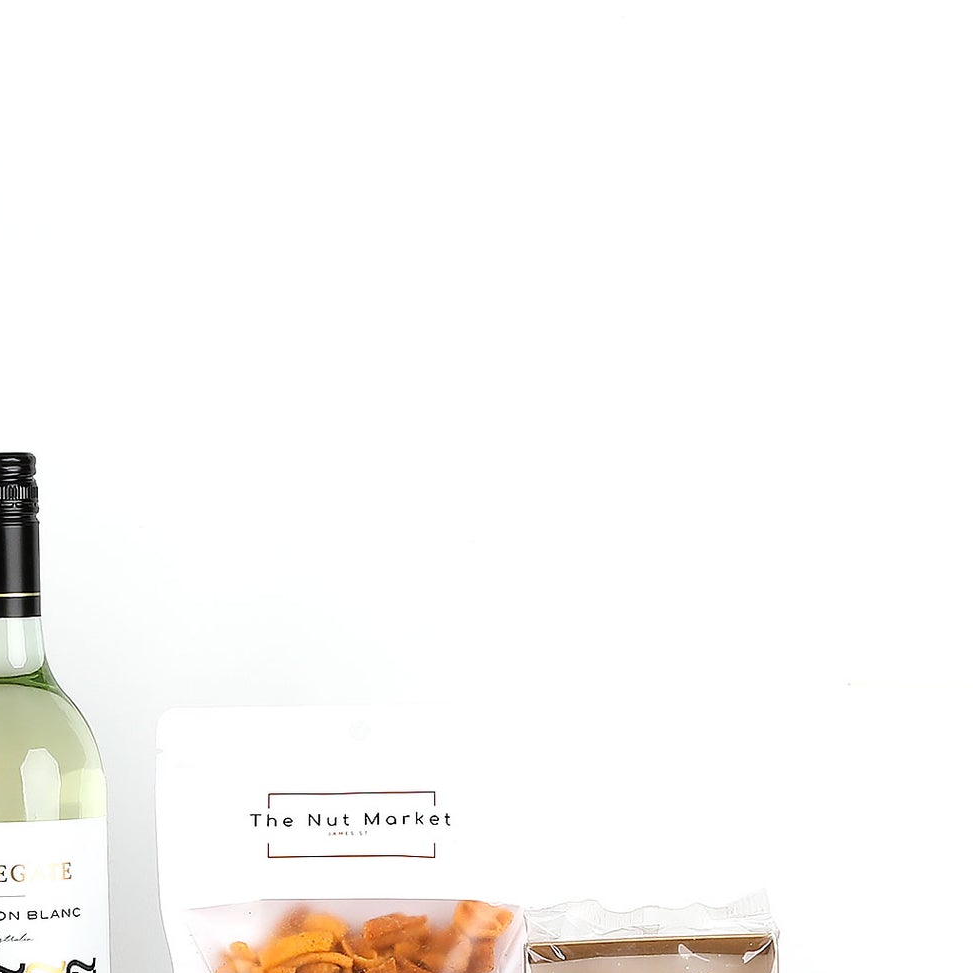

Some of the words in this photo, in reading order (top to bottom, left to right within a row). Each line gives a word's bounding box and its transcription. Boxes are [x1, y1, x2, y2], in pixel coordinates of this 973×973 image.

[250, 813, 294, 828] The
[308, 813, 350, 827] Nut
[364, 811, 451, 827] Market
[27, 907, 81, 920] BLANC
